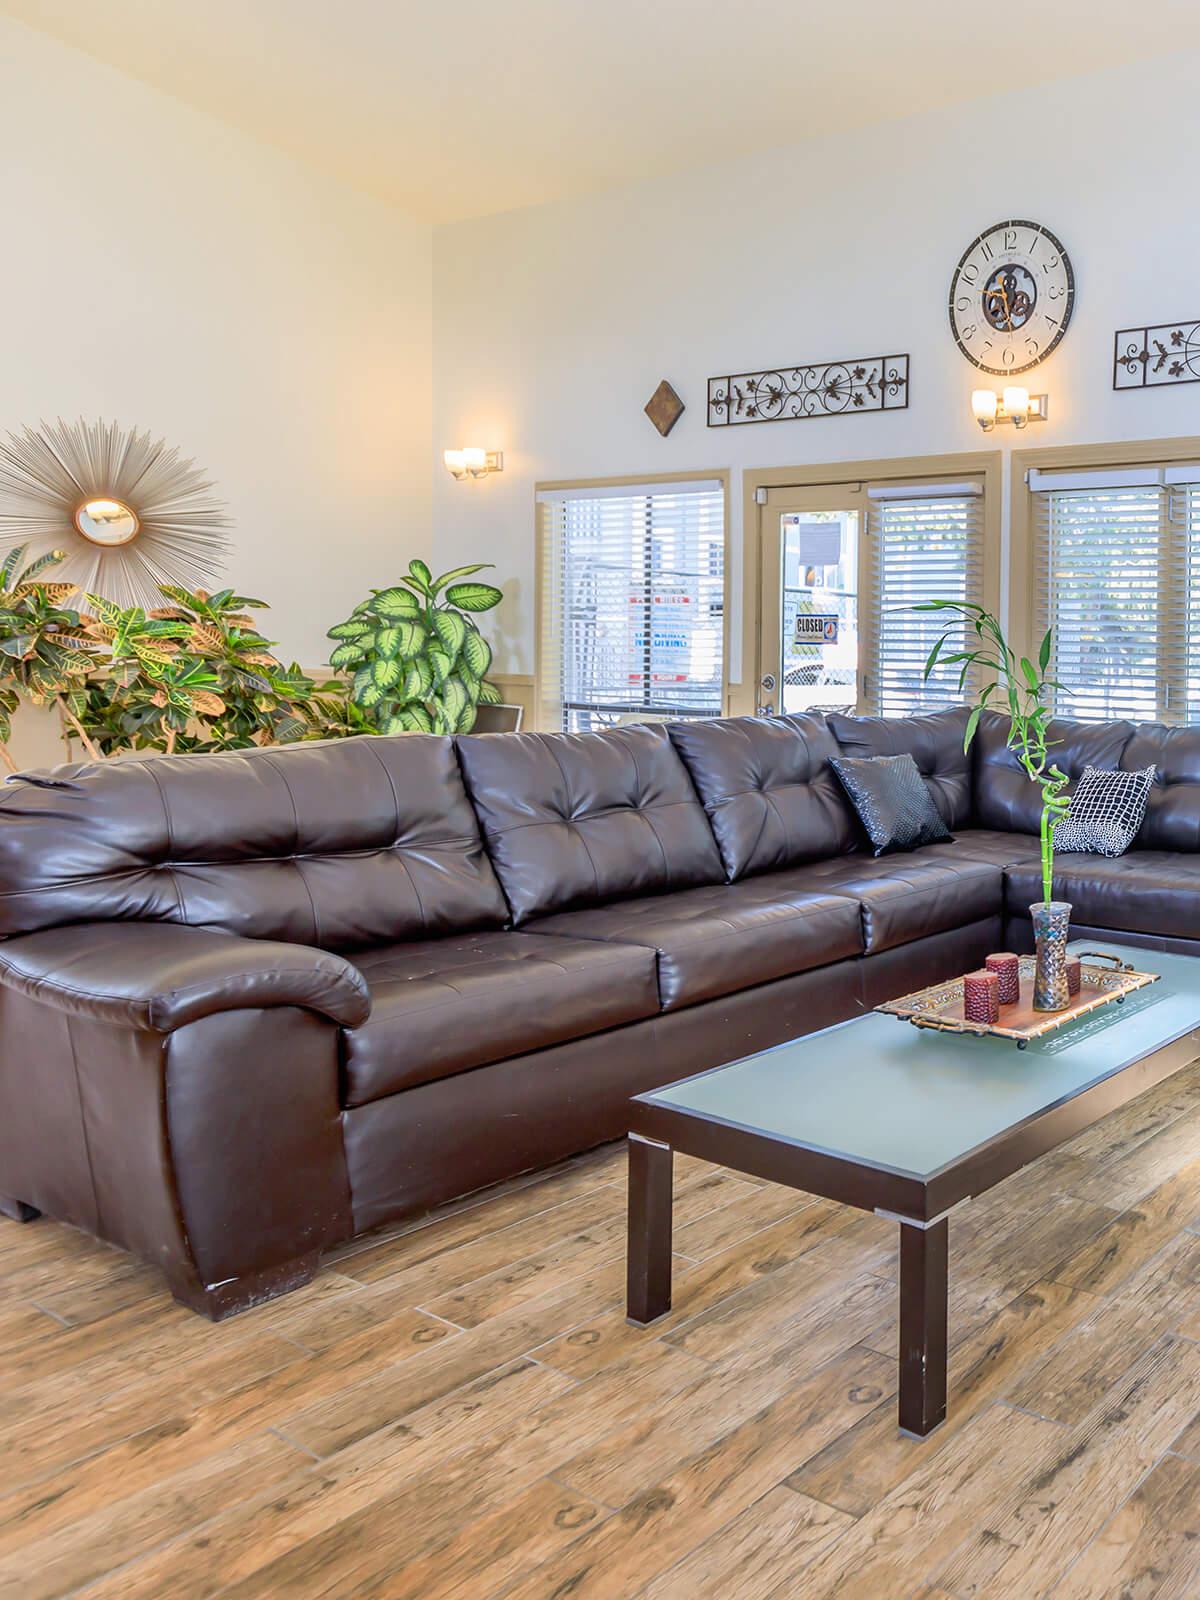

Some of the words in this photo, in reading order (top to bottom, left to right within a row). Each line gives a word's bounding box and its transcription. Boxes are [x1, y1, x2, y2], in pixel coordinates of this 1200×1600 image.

[1004, 231, 1017, 251] 12
[1028, 236, 1038, 255] 1
[981, 241, 994, 261] 11
[1042, 255, 1059, 274] 2
[961, 263, 980, 286] 10
[1048, 286, 1065, 300] 3
[956, 297, 972, 312] 9
[1044, 315, 1058, 330] 4
[961, 324, 977, 340] 8
[979, 341, 993, 359] 7
[1024, 337, 1039, 355] 5
[1002, 347, 1015, 366] 6
[797, 619, 823, 632] CLOSED
